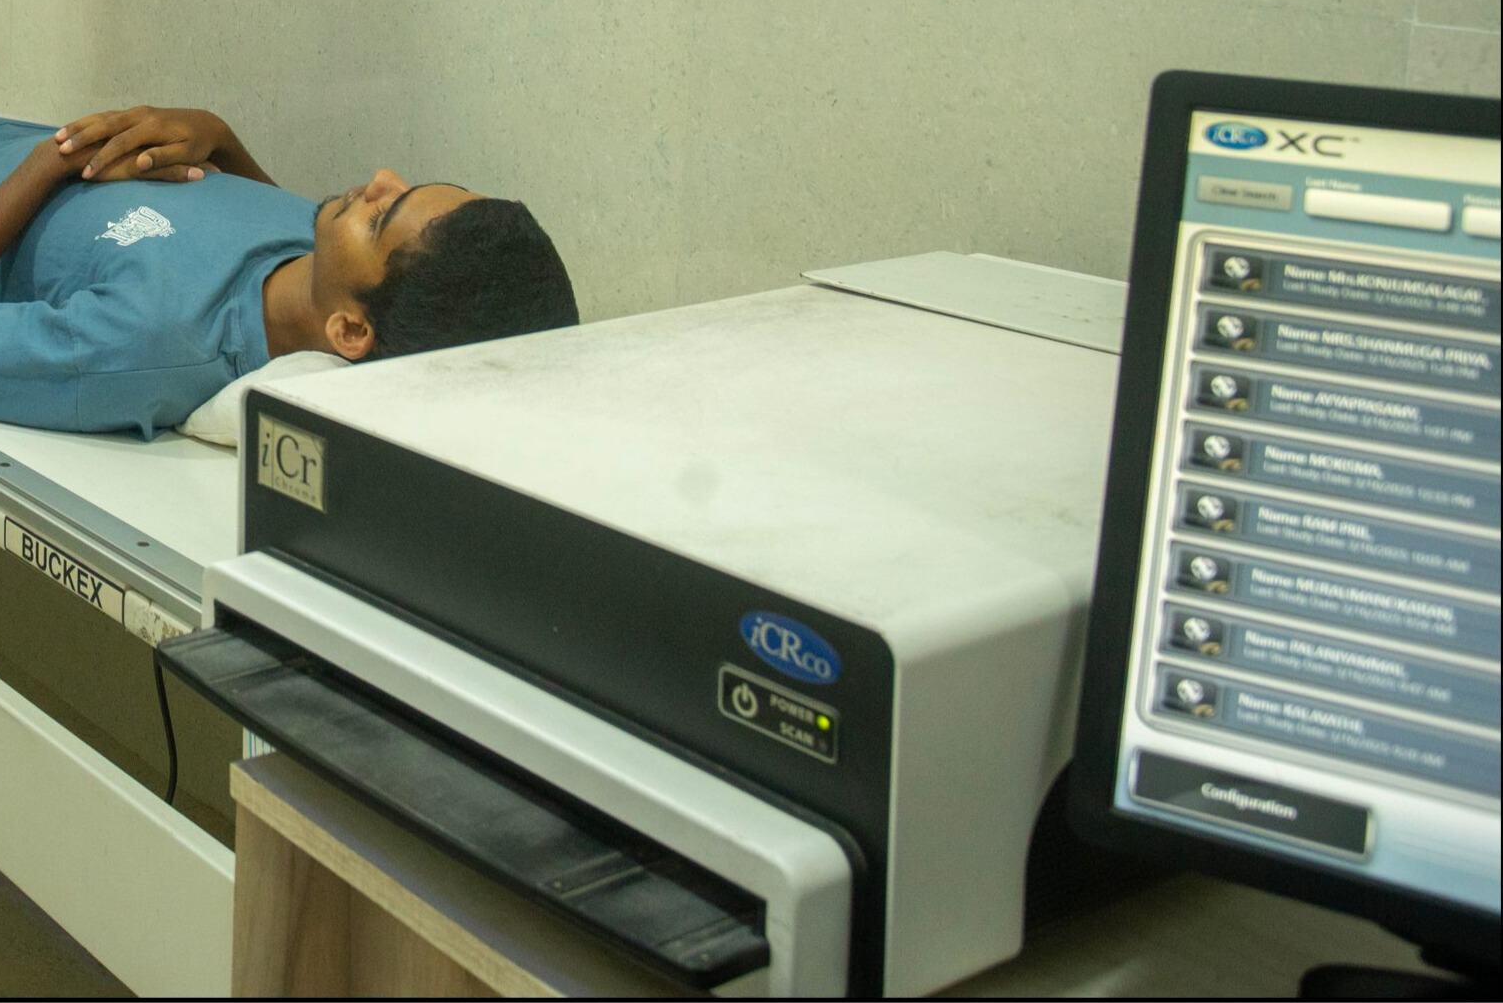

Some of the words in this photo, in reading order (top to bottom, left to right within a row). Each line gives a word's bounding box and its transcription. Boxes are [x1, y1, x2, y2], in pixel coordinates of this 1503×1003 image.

[1284, 264, 1327, 282] Name
[1278, 323, 1320, 342] Name
[1271, 384, 1314, 403] Name
[1265, 445, 1307, 464] Name
[1258, 506, 1301, 526] Name
[22, 533, 103, 609] BUCKEX
[1251, 567, 1295, 588] Name
[751, 616, 832, 679] iCRco
[1245, 629, 1288, 650] Name
[770, 694, 815, 724] POWER
[1238, 691, 1282, 713] Name
[779, 721, 815, 746] SCAN
[1201, 782, 1297, 821] Configuration
